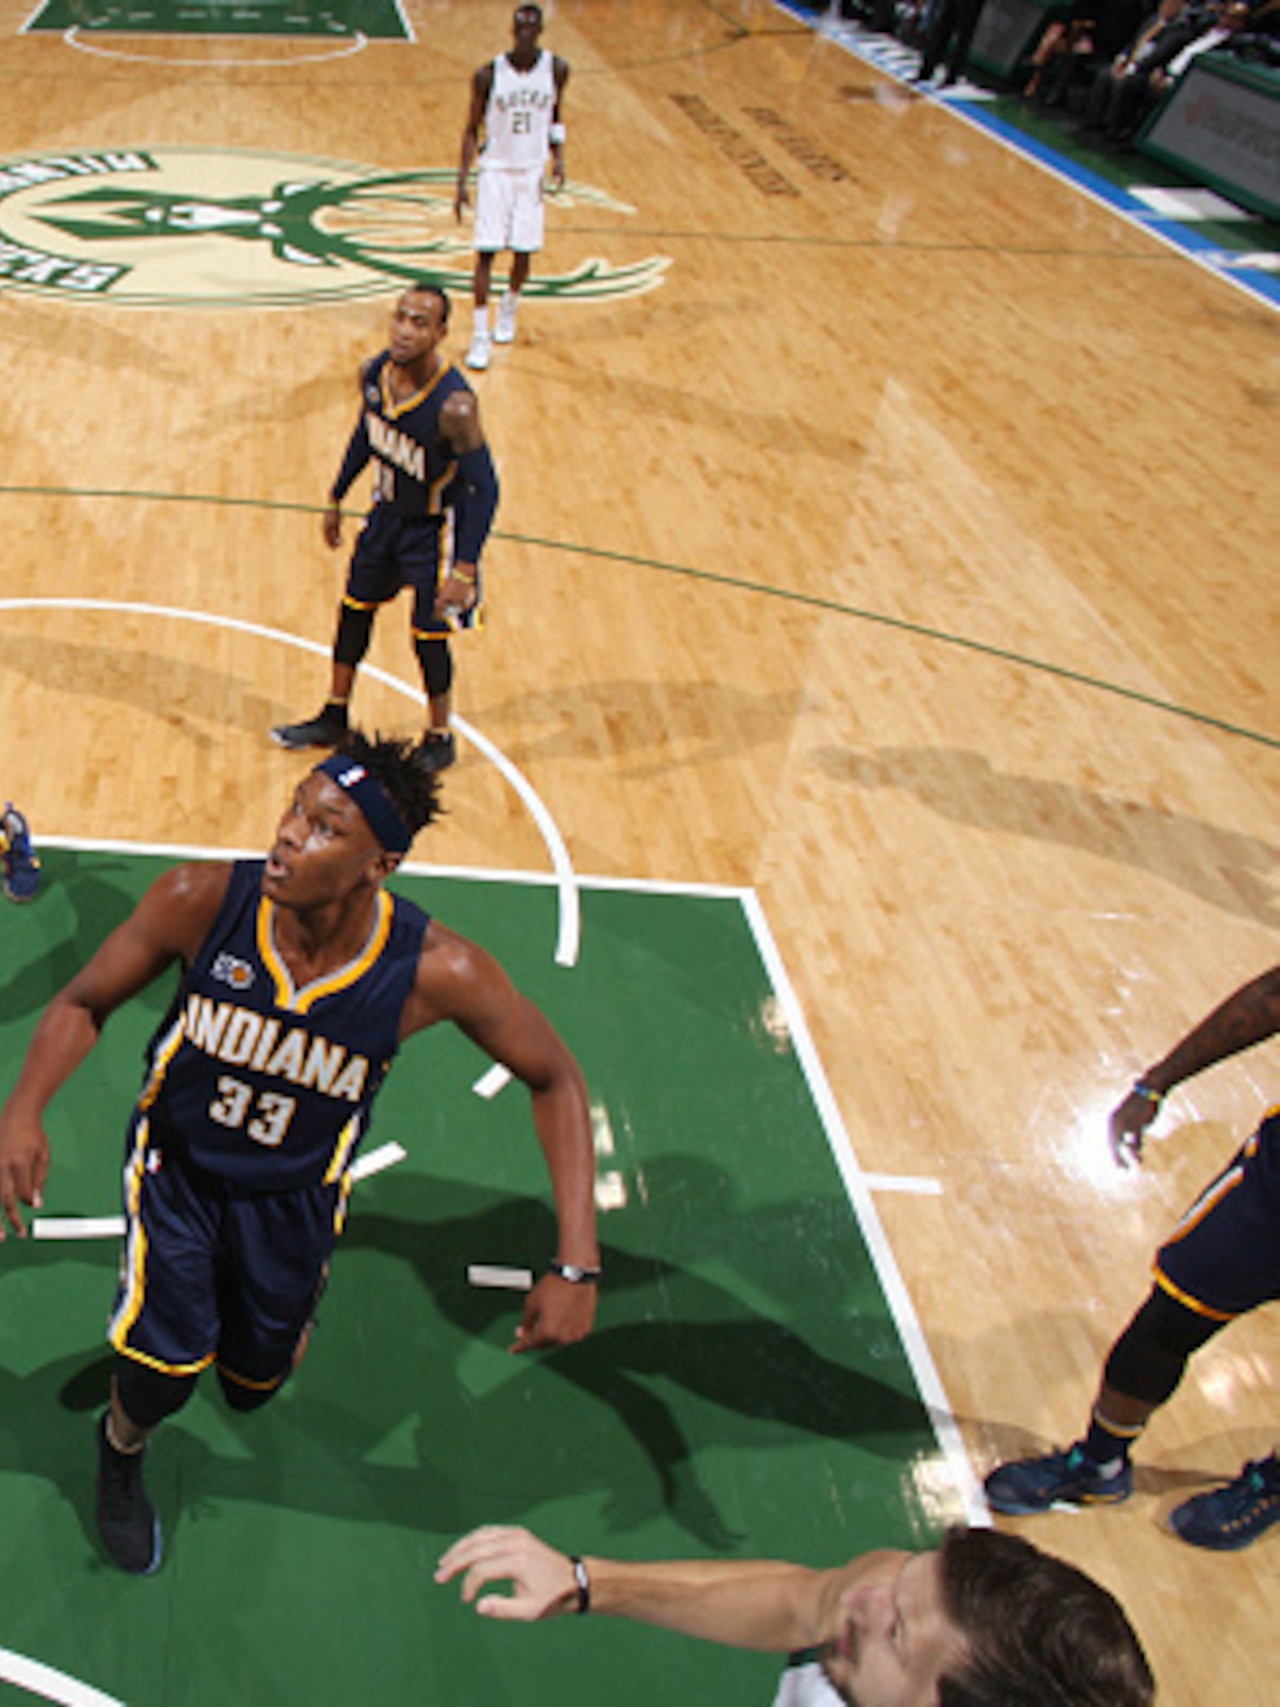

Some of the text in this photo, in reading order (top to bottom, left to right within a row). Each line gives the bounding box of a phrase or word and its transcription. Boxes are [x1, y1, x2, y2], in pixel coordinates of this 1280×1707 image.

[512, 111, 531, 134] 21
[184, 994, 369, 1102] INDIANA
[209, 1076, 296, 1147] 33
